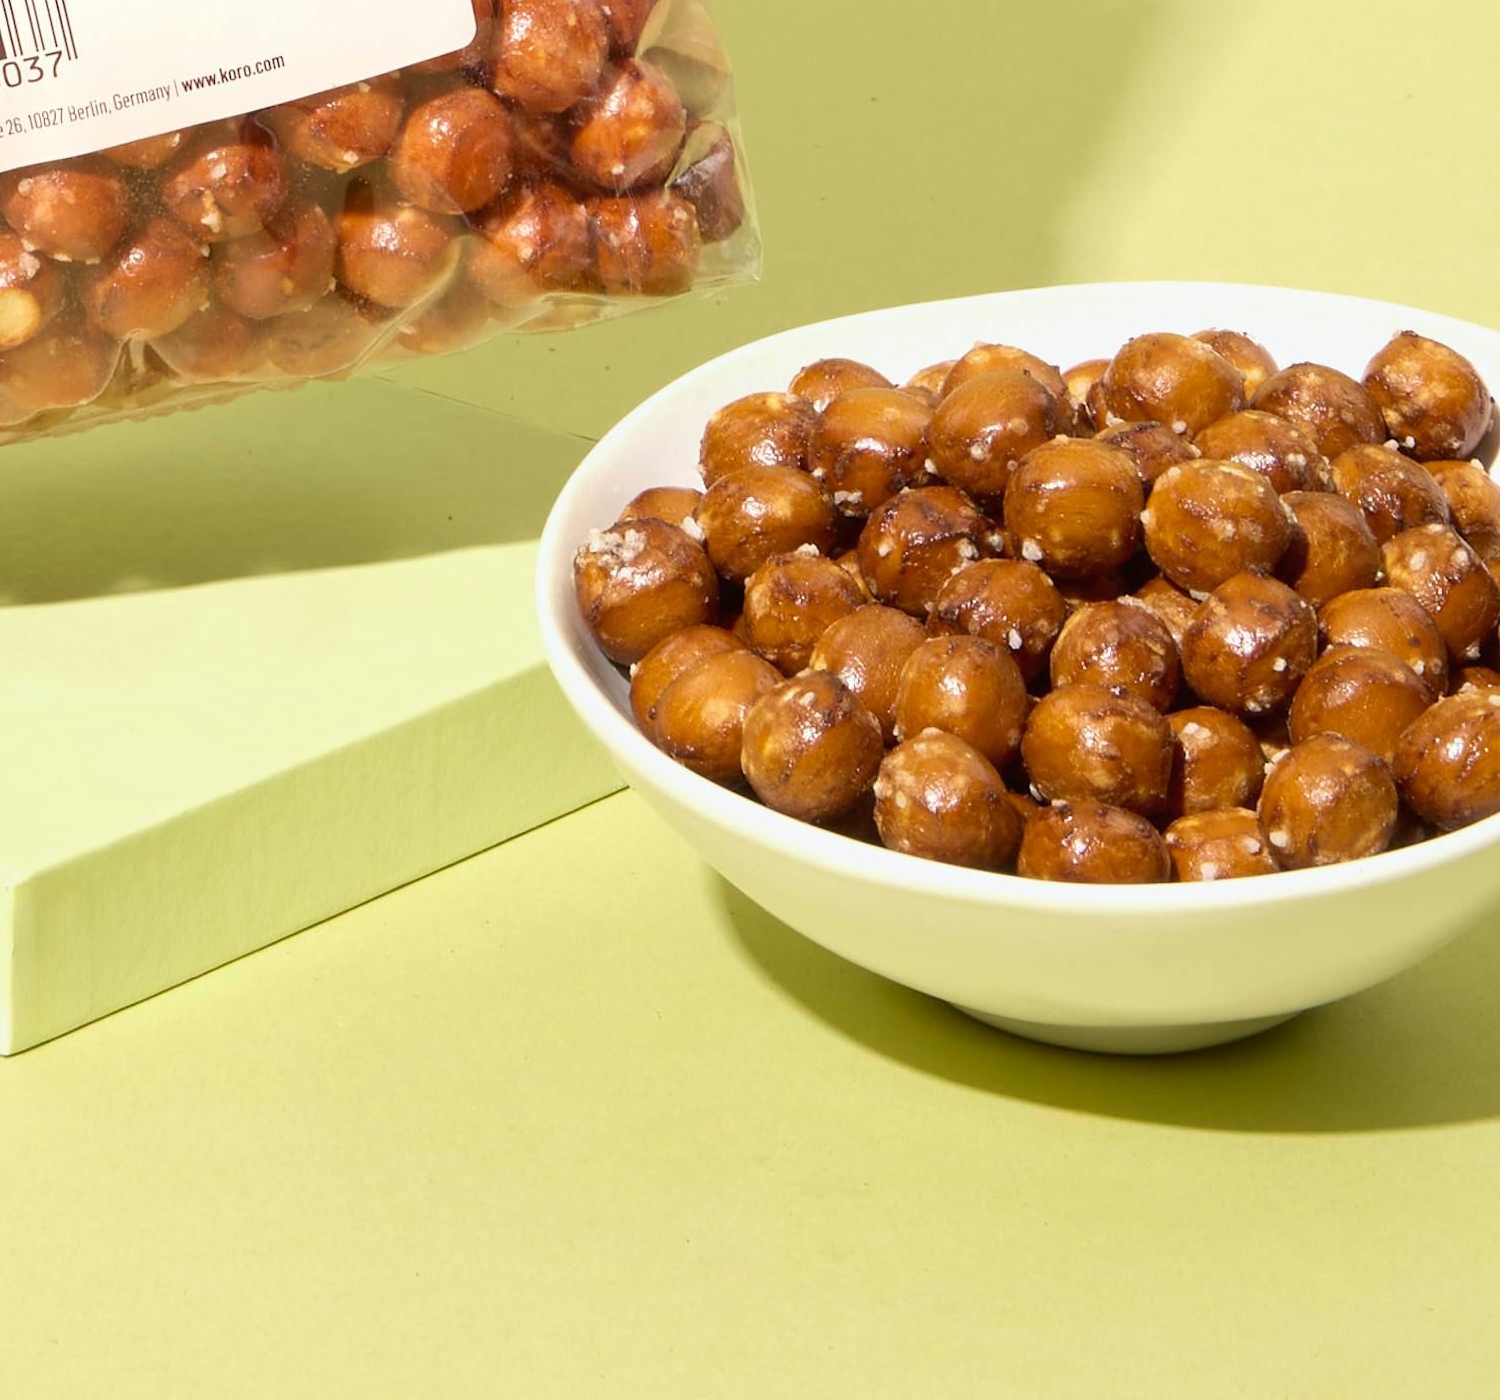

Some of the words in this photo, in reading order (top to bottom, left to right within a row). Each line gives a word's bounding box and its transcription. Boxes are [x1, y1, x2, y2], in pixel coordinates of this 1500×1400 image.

[4, 116, 27, 136] 26,
[27, 107, 64, 131] 10827
[67, 99, 112, 123] Berlin,
[112, 84, 171, 111] Germany
[181, 55, 286, 93] www.koro.com
